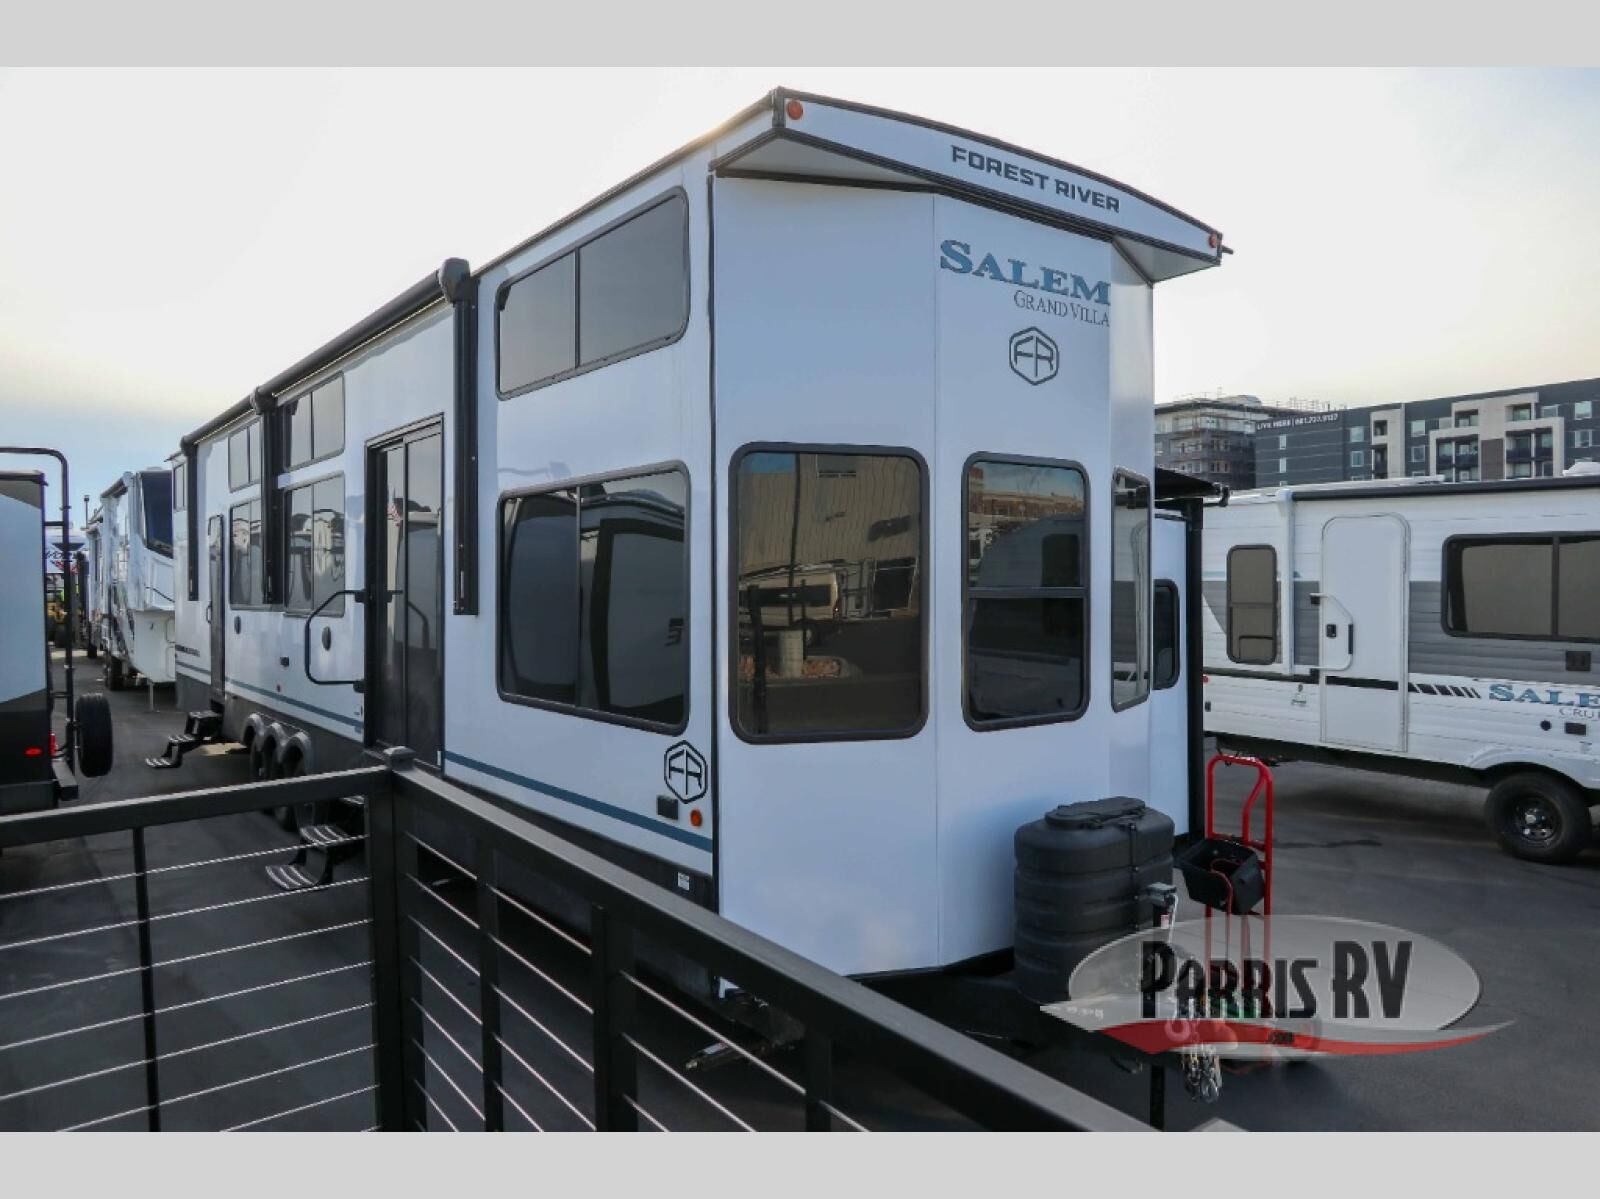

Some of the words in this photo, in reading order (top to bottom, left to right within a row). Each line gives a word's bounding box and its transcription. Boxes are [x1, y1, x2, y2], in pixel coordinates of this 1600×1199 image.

[951, 145, 1049, 190] FOREST
[1055, 178, 1120, 213] RIVER
[940, 240, 1111, 306] SALEM
[1014, 290, 1067, 318] GRAND
[1070, 304, 1111, 327] VILLA
